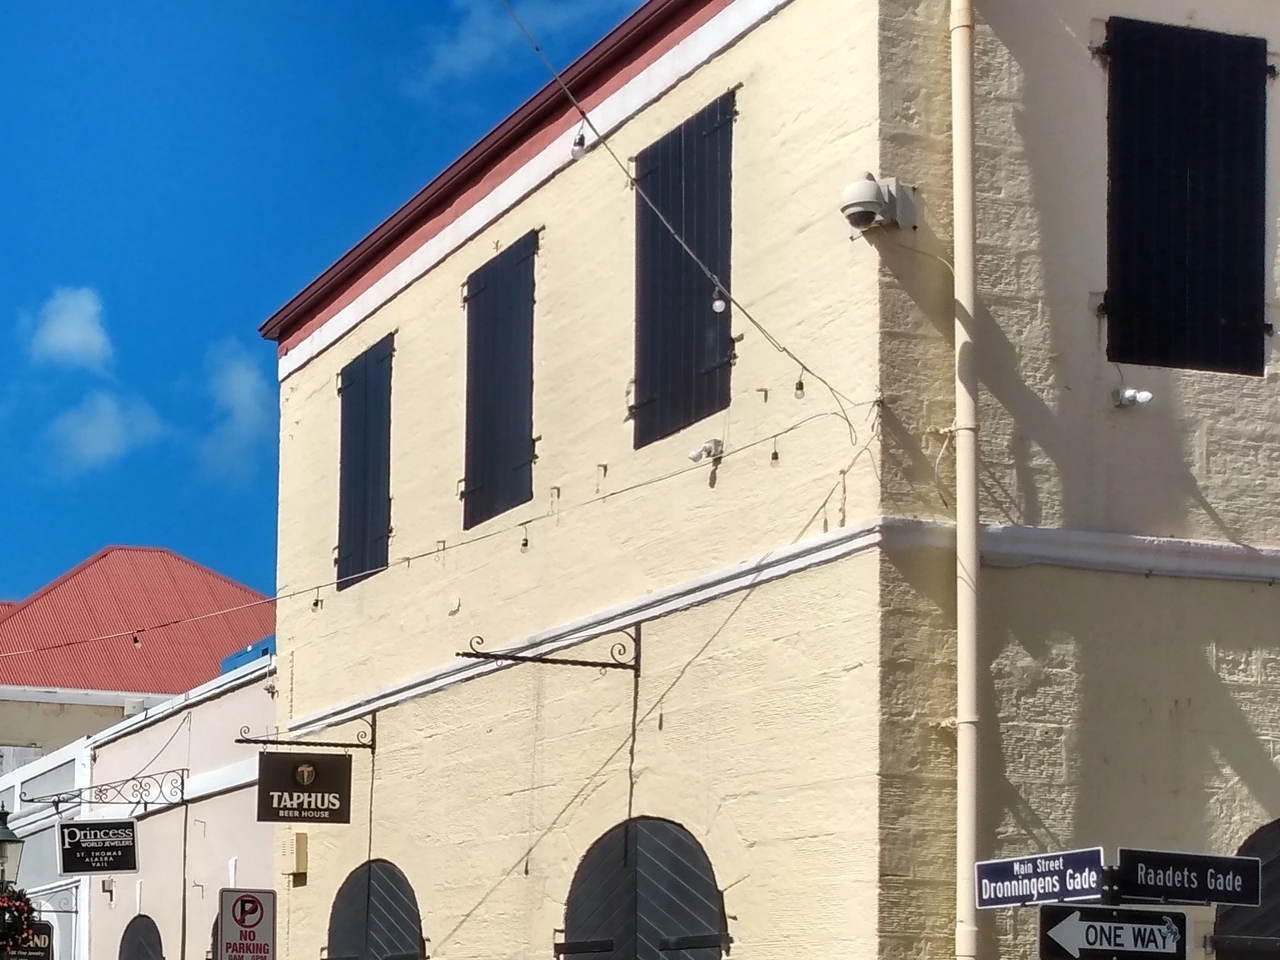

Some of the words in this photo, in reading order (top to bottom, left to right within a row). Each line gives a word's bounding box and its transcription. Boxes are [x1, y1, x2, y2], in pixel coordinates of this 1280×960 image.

[269, 791, 341, 809] TAPHUS
[301, 810, 330, 818] HOUSE
[62, 827, 133, 849] Princess
[1013, 861, 1033, 875] Main
[1036, 856, 1064, 873] Street
[981, 875, 1060, 901] Dronningens
[1066, 867, 1097, 890] Gade
[1137, 863, 1198, 889] Raadets
[1207, 868, 1243, 892] Gade
[239, 930, 256, 941] NO
[1085, 924, 1125, 947] ONE
[1132, 926, 1170, 949] WAY
[225, 942, 270, 954] PARKING
